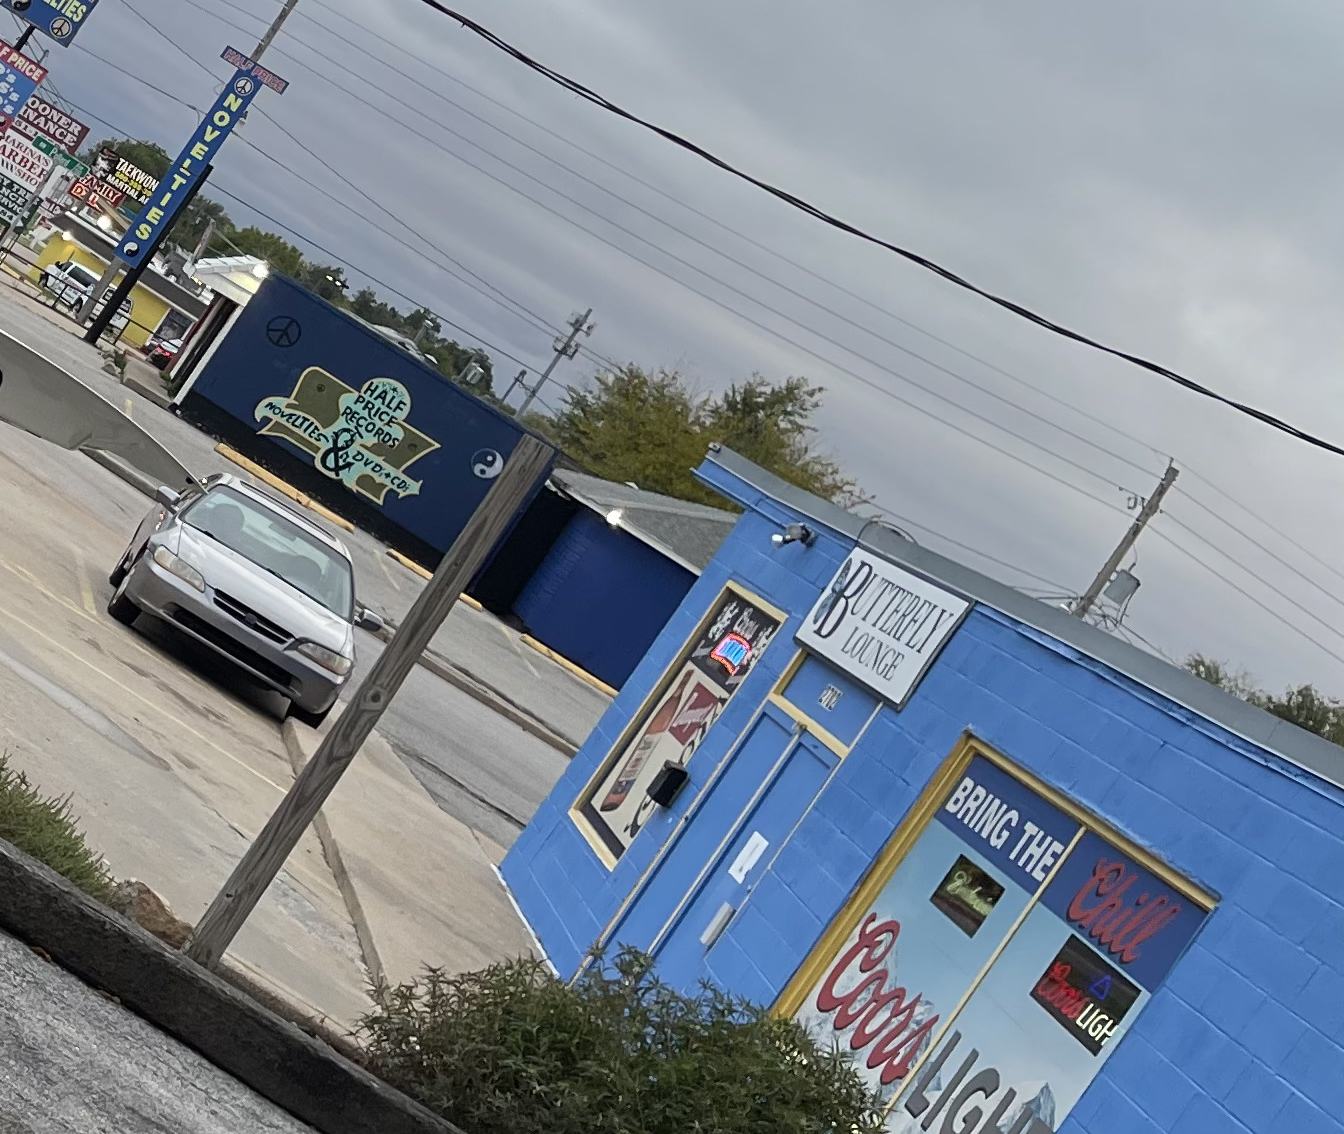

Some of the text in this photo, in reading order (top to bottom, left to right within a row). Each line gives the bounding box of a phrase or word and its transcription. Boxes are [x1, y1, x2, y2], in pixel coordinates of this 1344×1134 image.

[7, 52, 45, 82] PRICE
[222, 48, 287, 92] HALF PRICE
[19, 105, 78, 147] INANCE
[27, 96, 82, 135] OONER
[115, 157, 160, 192] TAEKWON
[135, 93, 243, 241] NOVELTIES
[354, 394, 398, 429] PRICE
[363, 381, 407, 414] HALF
[264, 400, 330, 444] NOVELTIES
[340, 405, 400, 449] RECORDS
[813, 559, 955, 655] BUTTERFLY
[840, 625, 907, 682] LOUNGE
[944, 776, 1066, 882] BRING THE
[1066, 856, 1182, 964] Chill
[816, 911, 940, 1086] Coors
[1075, 1003, 1118, 1046] LIGH
[904, 1029, 1054, 1134] LIGH
